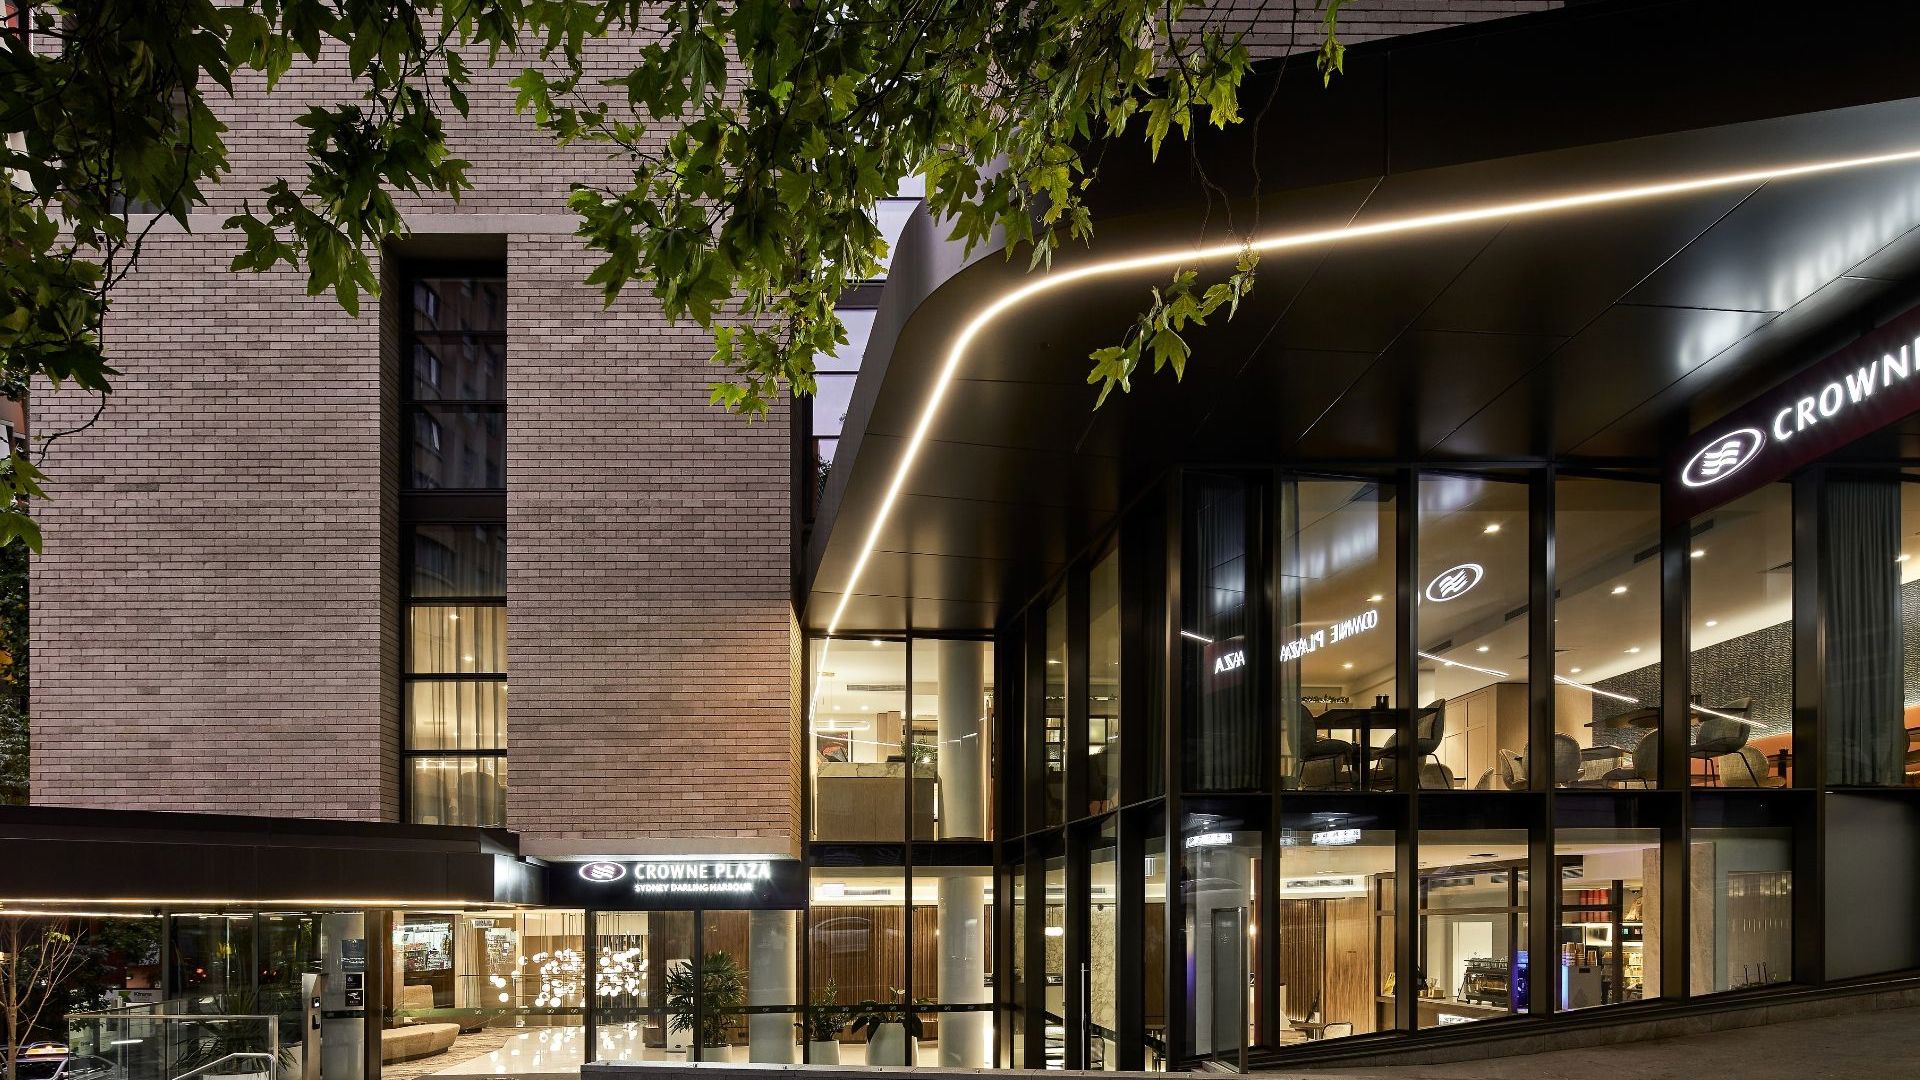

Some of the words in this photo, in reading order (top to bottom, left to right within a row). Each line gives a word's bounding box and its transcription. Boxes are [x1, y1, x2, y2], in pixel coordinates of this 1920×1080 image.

[634, 863, 708, 879] CROWNE
[715, 862, 771, 880] PLAZA
[634, 883, 668, 892] SYDNEY
[670, 883, 708, 892] DARLING
